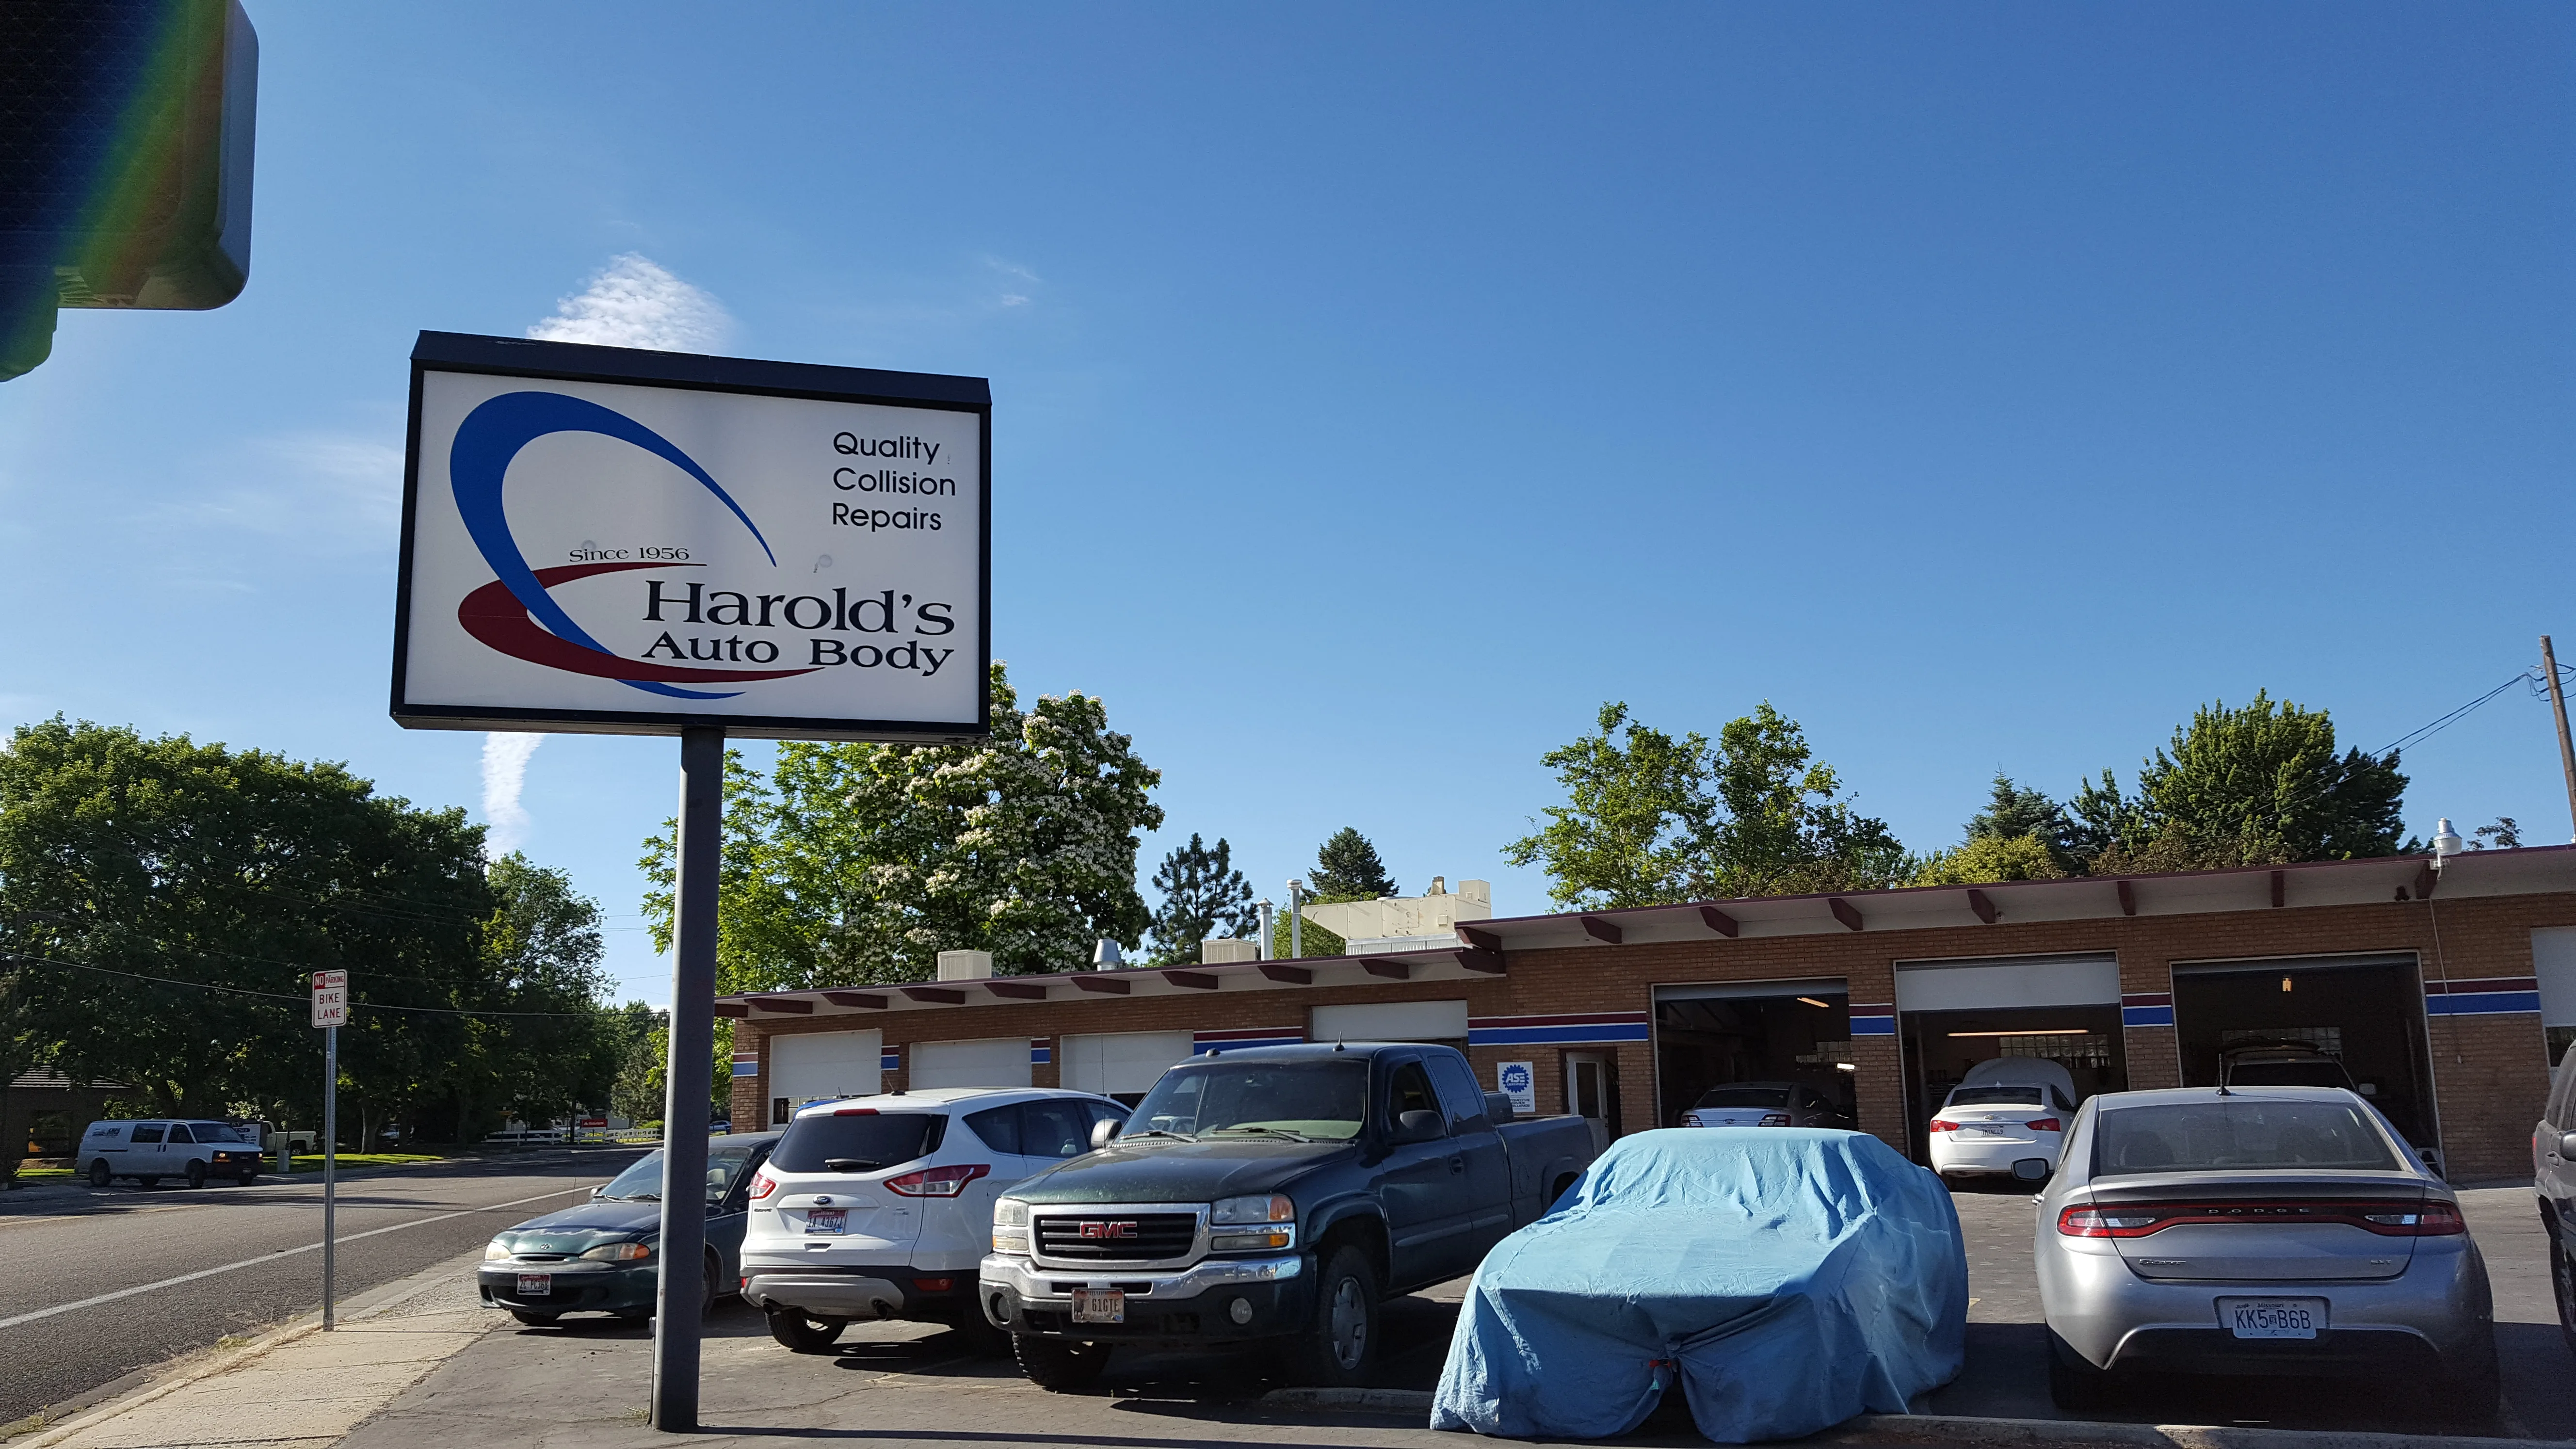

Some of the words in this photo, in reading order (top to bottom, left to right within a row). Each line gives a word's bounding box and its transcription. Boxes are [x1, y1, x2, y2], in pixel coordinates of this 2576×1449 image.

[833, 431, 940, 466] Quality
[833, 467, 956, 496] Collision
[832, 502, 942, 532] Repairs
[569, 547, 629, 562] Since
[639, 547, 690, 561] 1956
[642, 580, 955, 636] Harold's
[641, 630, 779, 664] Auto
[808, 638, 955, 677] Body
[315, 976, 324, 986] NO
[319, 993, 339, 1004] BIKE
[318, 1008, 341, 1019] LANE
[1505, 1073, 1525, 1083] ASE
[1080, 1221, 1138, 1239] GMC
[520, 1280, 527, 1289] 2C
[531, 1280, 548, 1289] PC368
[2235, 1310, 2269, 1329] KK5
[2277, 1310, 2311, 1329] B6B
